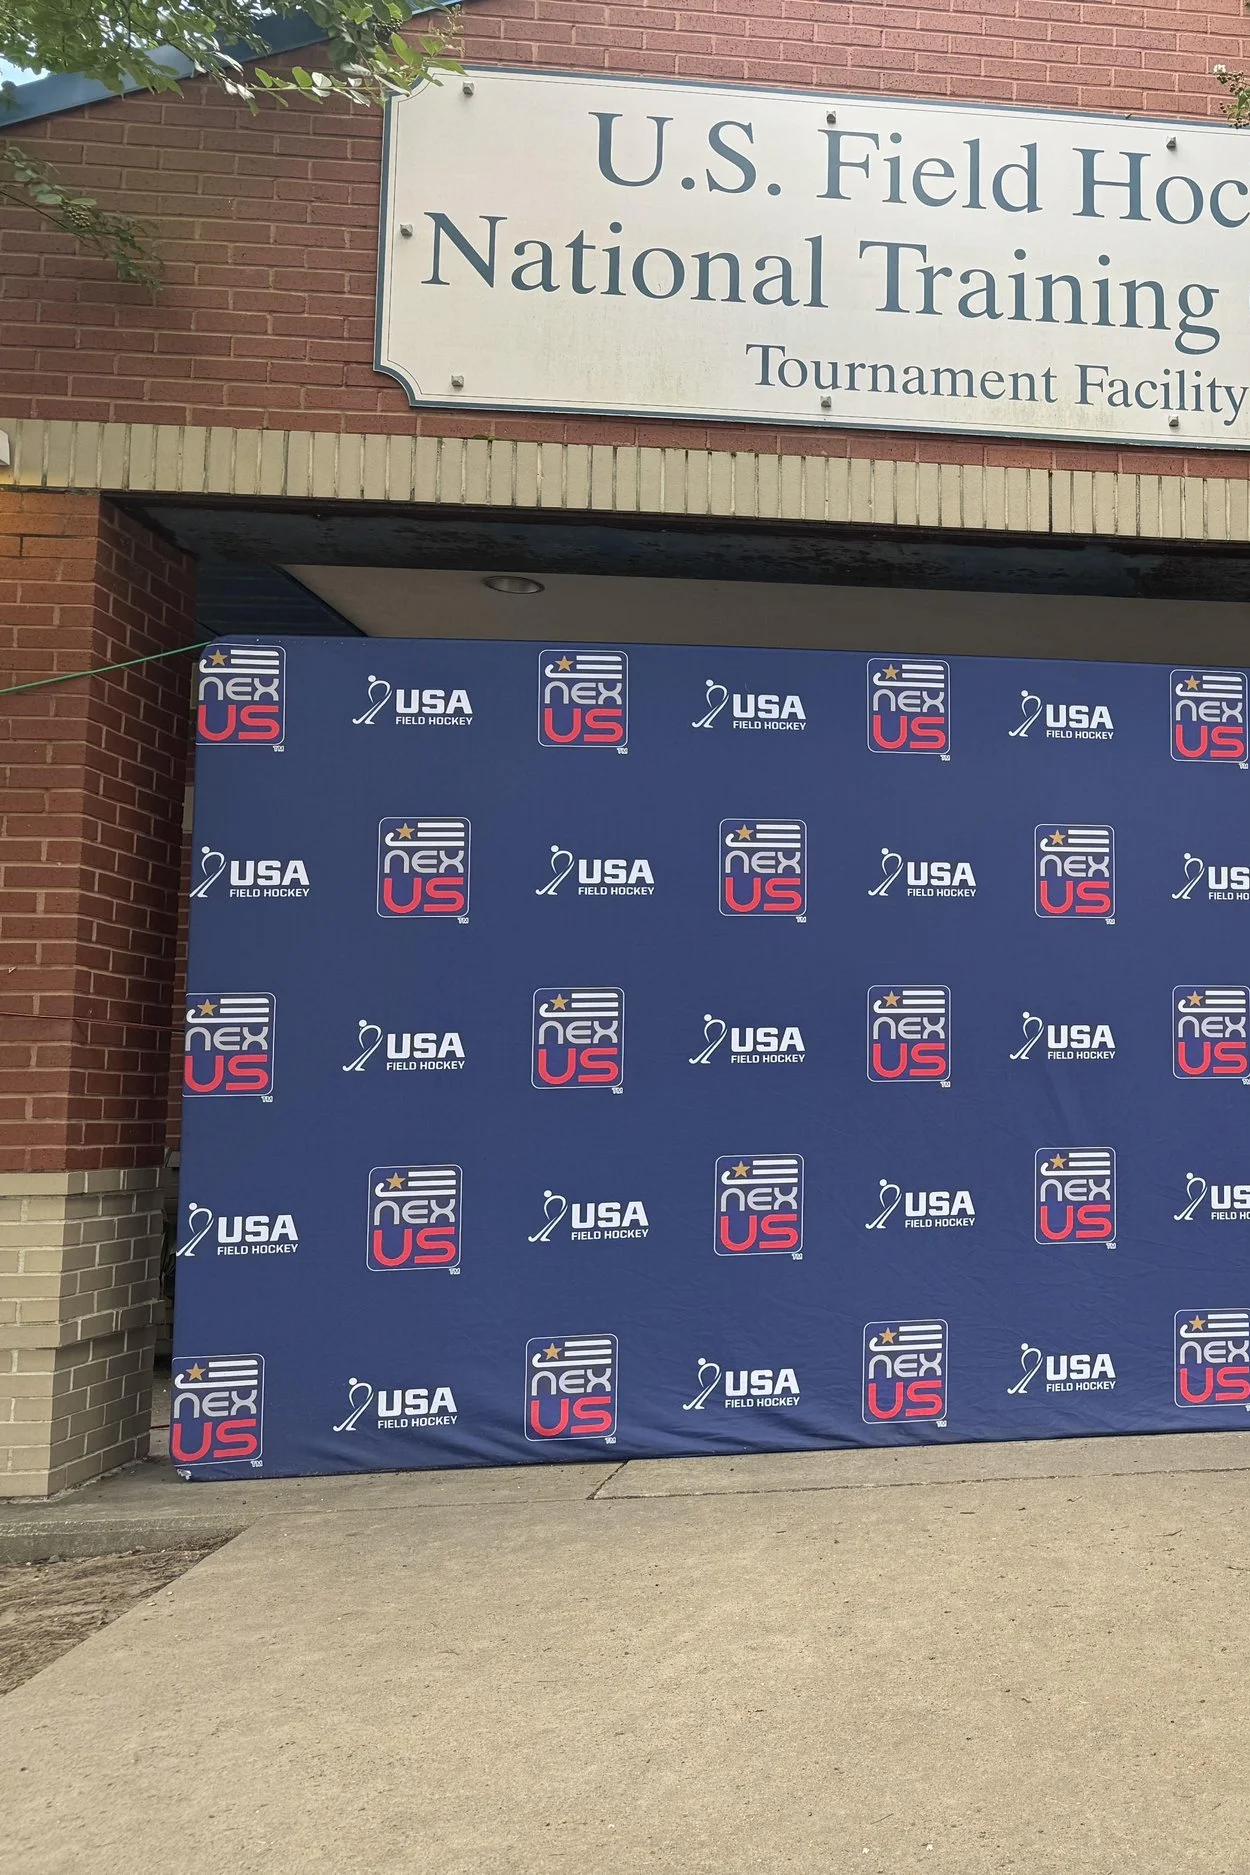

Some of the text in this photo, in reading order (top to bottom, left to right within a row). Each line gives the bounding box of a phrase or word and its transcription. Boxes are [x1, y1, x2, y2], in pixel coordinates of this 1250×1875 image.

[591, 112, 782, 196] U.S.
[815, 127, 1043, 214] Field
[421, 212, 828, 308] National
[859, 240, 1220, 355] Training
[746, 344, 1249, 427] Tournament Facility
[395, 688, 473, 715] USA
[732, 693, 807, 720] USA
[197, 704, 280, 742] US
[395, 716, 473, 726] FIELD HOCKEY
[544, 707, 624, 743] US
[732, 720, 807, 731] FIELD HOCKEY
[1045, 703, 1114, 730] USA
[872, 714, 947, 750] US
[1046, 729, 1114, 740] FIELD HOCKEY
[1175, 724, 1245, 758] US
[229, 860, 310, 886] USA
[578, 859, 655, 884] USA
[906, 861, 977, 887] USA
[229, 888, 310, 898] FIELD HOCKEY
[383, 876, 465, 914] US
[578, 886, 655, 896] FIELD HOCKEY
[725, 876, 803, 913] US
[907, 888, 977, 898] FIELD HOCKEY
[1039, 880, 1112, 915] US
[1208, 891, 1234, 901] FIELD
[386, 1032, 466, 1060] USA
[730, 1026, 806, 1053] USA
[1047, 1024, 1116, 1049] USA
[386, 1060, 465, 1071] FIELD HOCKEY
[538, 1047, 619, 1085] US
[730, 1053, 806, 1064] FIELD HOCKEY
[872, 1042, 947, 1079] US
[1047, 1050, 1116, 1060] FIELD HOCKEY
[1177, 1041, 1248, 1076] US
[184, 1054, 269, 1093] US
[571, 1200, 649, 1229] USA
[905, 1190, 976, 1217] USA
[1210, 1211, 1238, 1221] FIELD
[217, 1214, 299, 1244] USA
[571, 1228, 649, 1241] FIELD HOCKEY
[720, 1213, 799, 1252] US
[904, 1217, 976, 1229] FIELD HOCKEY
[1040, 1203, 1113, 1241] US
[217, 1243, 299, 1256] FIELD HOCKEY
[373, 1226, 457, 1267] US
[1046, 1353, 1117, 1381] USA
[725, 1368, 801, 1397] USA
[1046, 1380, 1116, 1393] FIELD HOCKEY
[377, 1386, 458, 1418] USA
[724, 1396, 801, 1409] FIELD HOCKEY
[867, 1379, 943, 1420] US
[377, 1415, 458, 1430] FIELD HOCKEY
[530, 1395, 613, 1437] US
[171, 1418, 258, 1462] US
